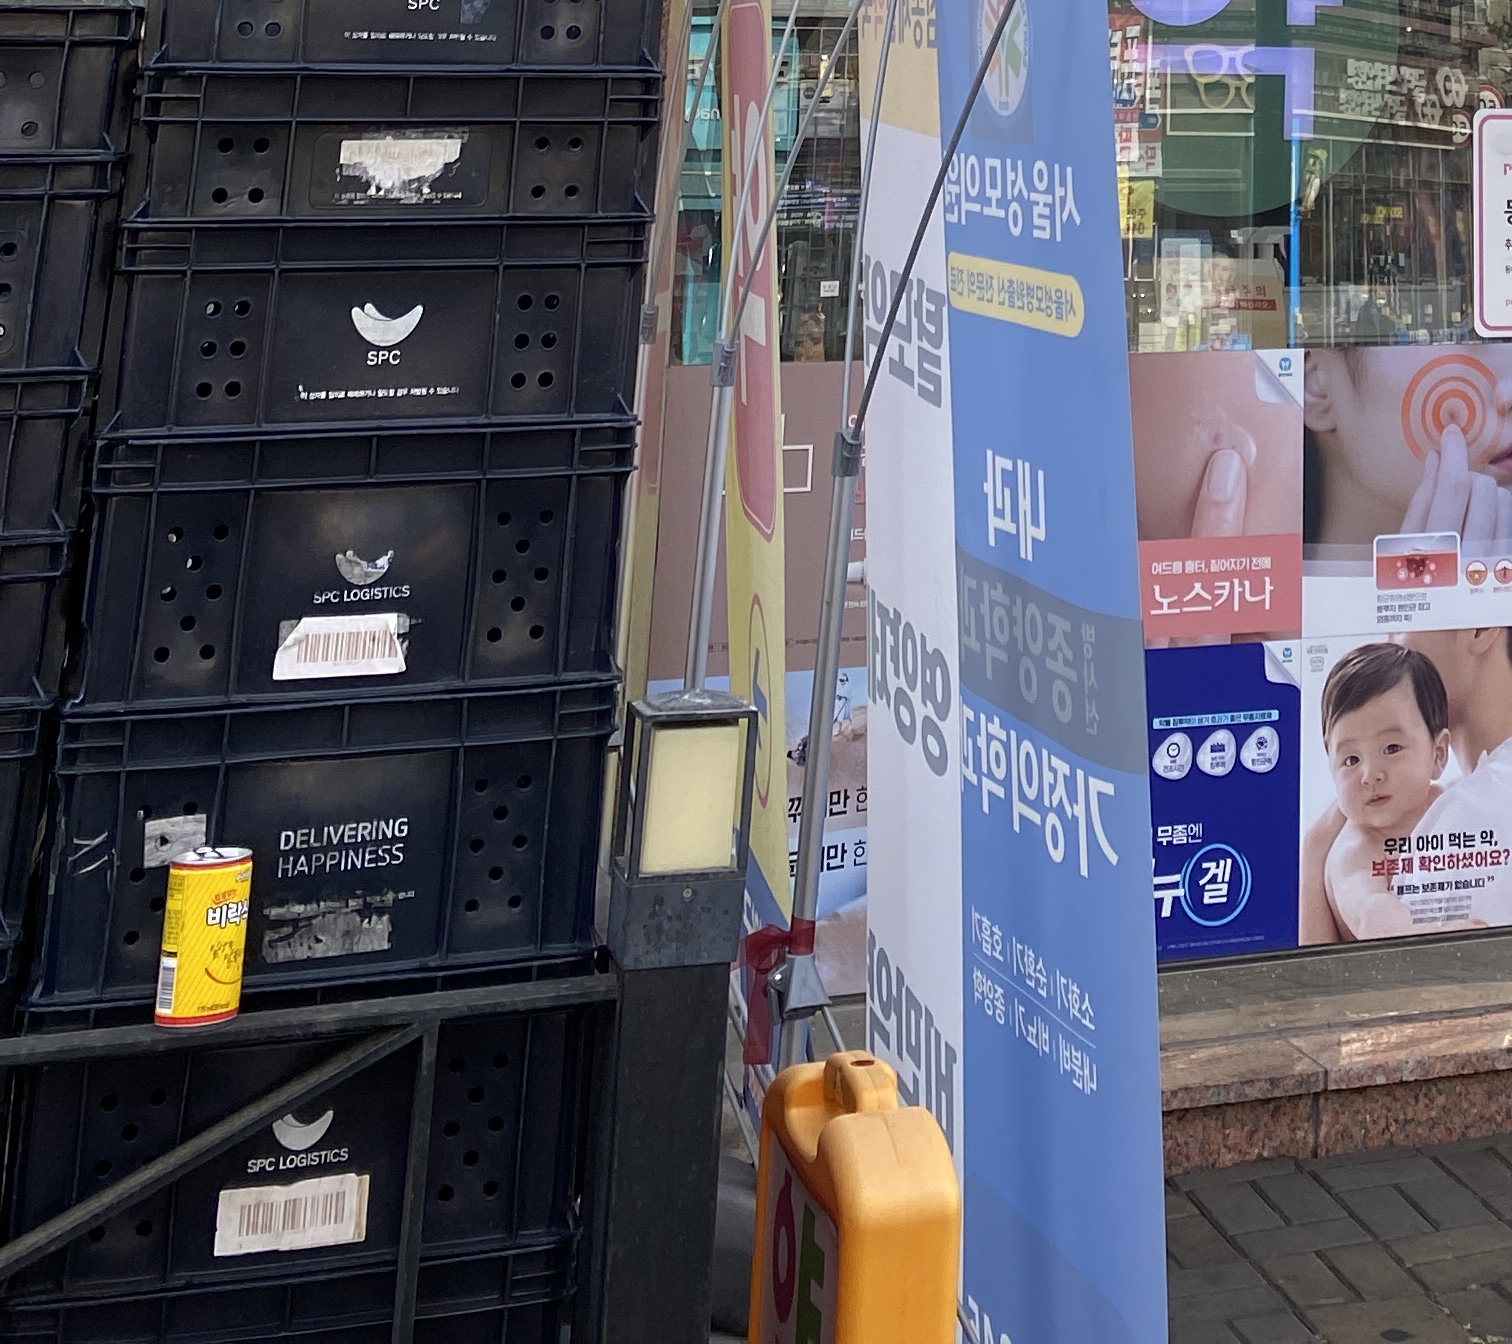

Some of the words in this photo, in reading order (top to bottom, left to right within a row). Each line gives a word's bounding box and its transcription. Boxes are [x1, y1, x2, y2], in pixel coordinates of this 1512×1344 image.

[366, 350, 401, 366] SPC
[313, 590, 341, 605] SPC
[342, 584, 412, 604] LOGISTICS
[1149, 576, 1275, 616] 노스카나
[279, 817, 410, 852] DELIVERING
[1156, 823, 1203, 846] 무좀엔
[1383, 836, 1412, 856] 우리
[1416, 833, 1444, 853] 아이
[1448, 831, 1476, 850] 먹는
[1479, 829, 1499, 847] 약,
[277, 843, 405, 879] HAPPINESS
[1371, 857, 1414, 878] 보존제
[1418, 848, 1511, 873] 확인하셨어요?
[1199, 858, 1232, 905] 겔
[247, 1156, 276, 1174] SPC
[277, 1147, 350, 1172] LOGISTICS
